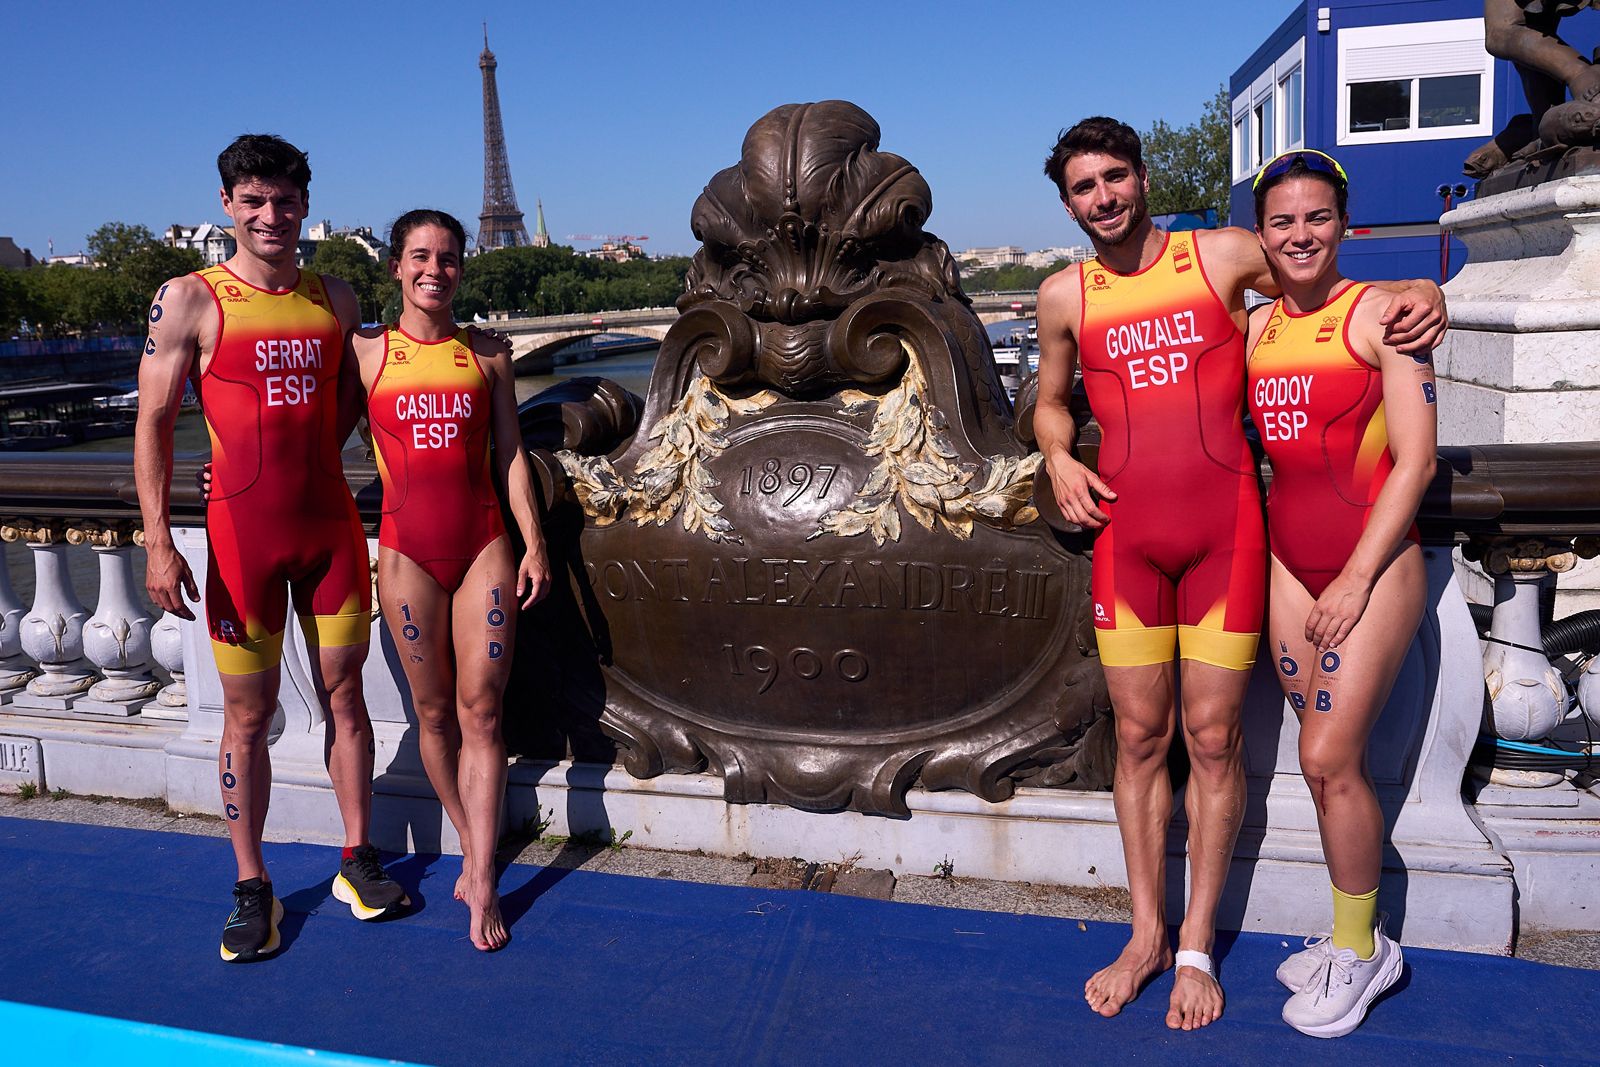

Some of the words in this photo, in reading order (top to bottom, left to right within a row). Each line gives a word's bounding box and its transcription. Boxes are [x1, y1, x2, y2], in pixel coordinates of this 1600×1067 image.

[145, 337, 156, 356] C
[1106, 310, 1204, 359] GONZALEZ
[255, 339, 322, 372] SERRAT
[1127, 352, 1189, 389] ESP
[266, 375, 317, 407] ESP
[1255, 374, 1314, 407] GODOY
[396, 393, 472, 421] CASILLAS
[412, 423, 458, 449] ESP
[1263, 411, 1308, 441] ESP
[741, 458, 840, 507] 1897
[488, 641, 503, 659] D
[721, 643, 869, 695] 1900
[1315, 689, 1333, 712] B
[225, 803, 240, 821] C
